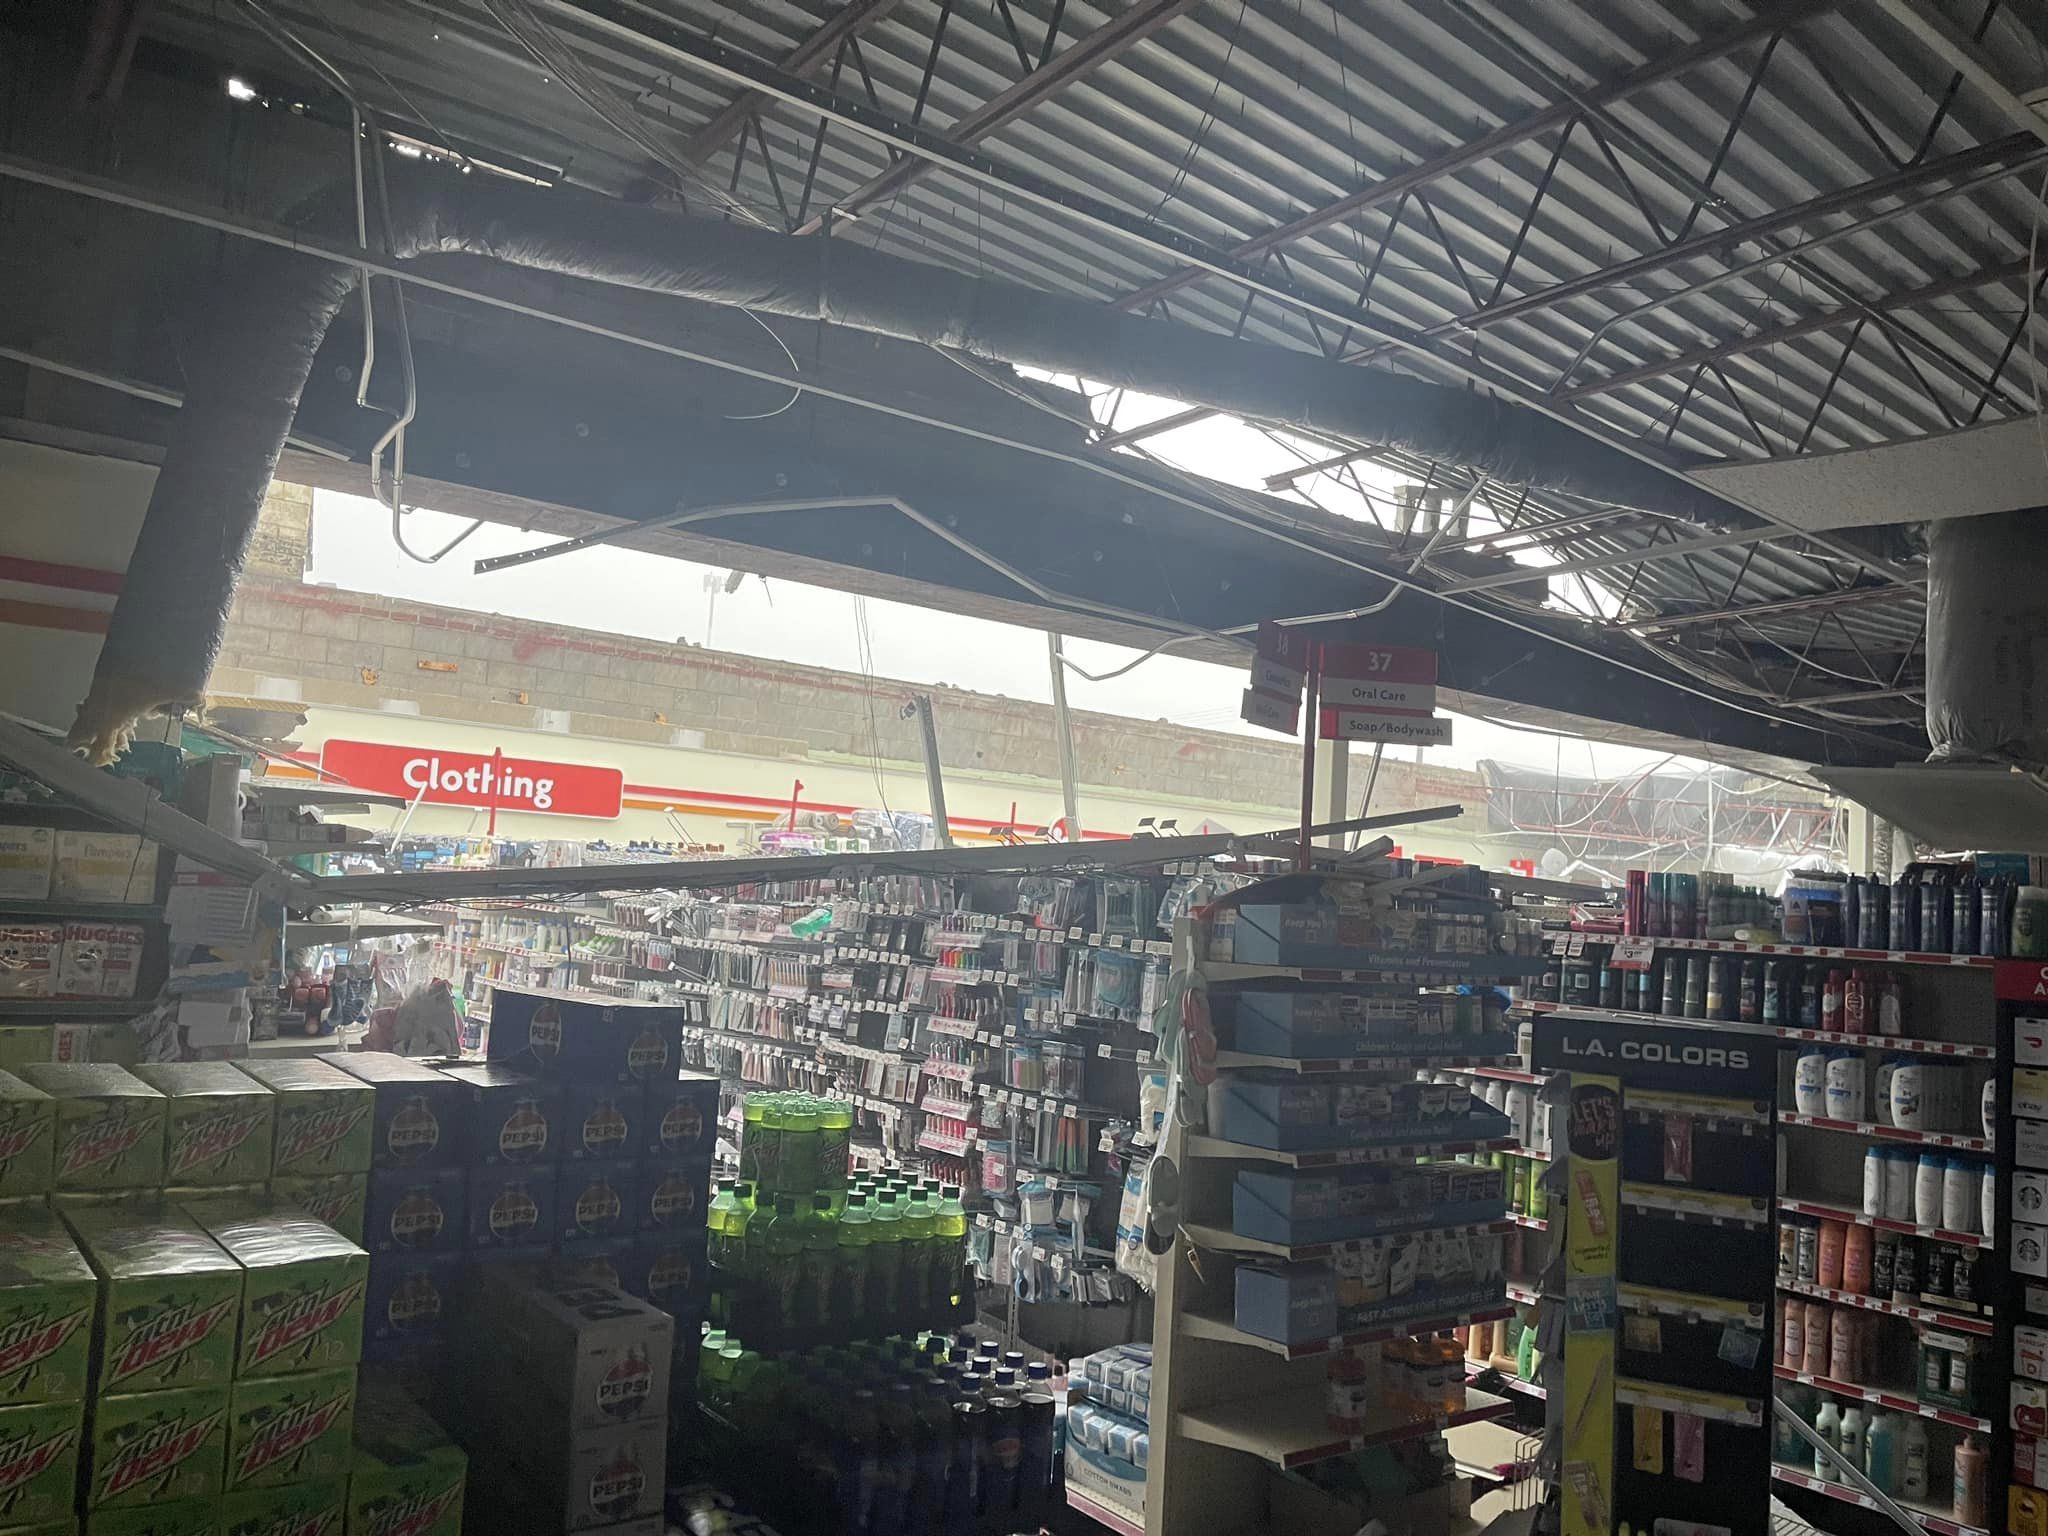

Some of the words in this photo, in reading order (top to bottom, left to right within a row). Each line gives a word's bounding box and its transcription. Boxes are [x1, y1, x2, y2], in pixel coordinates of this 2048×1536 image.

[1367, 650, 1393, 672] 37
[1352, 687, 1377, 699] Oral
[1380, 690, 1406, 701] Care
[1349, 720, 1444, 737] Soap/Bodywash
[403, 758, 554, 808] Clothing
[66, 925, 143, 944] HUGGIES
[532, 1024, 561, 1043] PEPSI
[630, 1050, 665, 1063] PEPSI
[1562, 1036, 1614, 1058] L.A.
[1620, 1041, 1750, 1070] COLORS
[392, 1130, 435, 1142] PEPSI
[585, 1127, 624, 1138] PEPSI
[662, 1124, 700, 1135] PEPSI
[503, 1131, 545, 1145] PEPSI
[579, 1203, 619, 1215] PEPSI
[655, 1197, 693, 1208] PEPSI
[395, 1215, 441, 1228] PEPSI
[493, 1209, 536, 1222] PEPSI
[323, 1341, 345, 1361] 12
[192, 1359, 215, 1380] 12
[600, 1379, 648, 1398] PEPSI
[1083, 1468, 1109, 1484] COTTON
[593, 1477, 643, 1498] PEPSI
